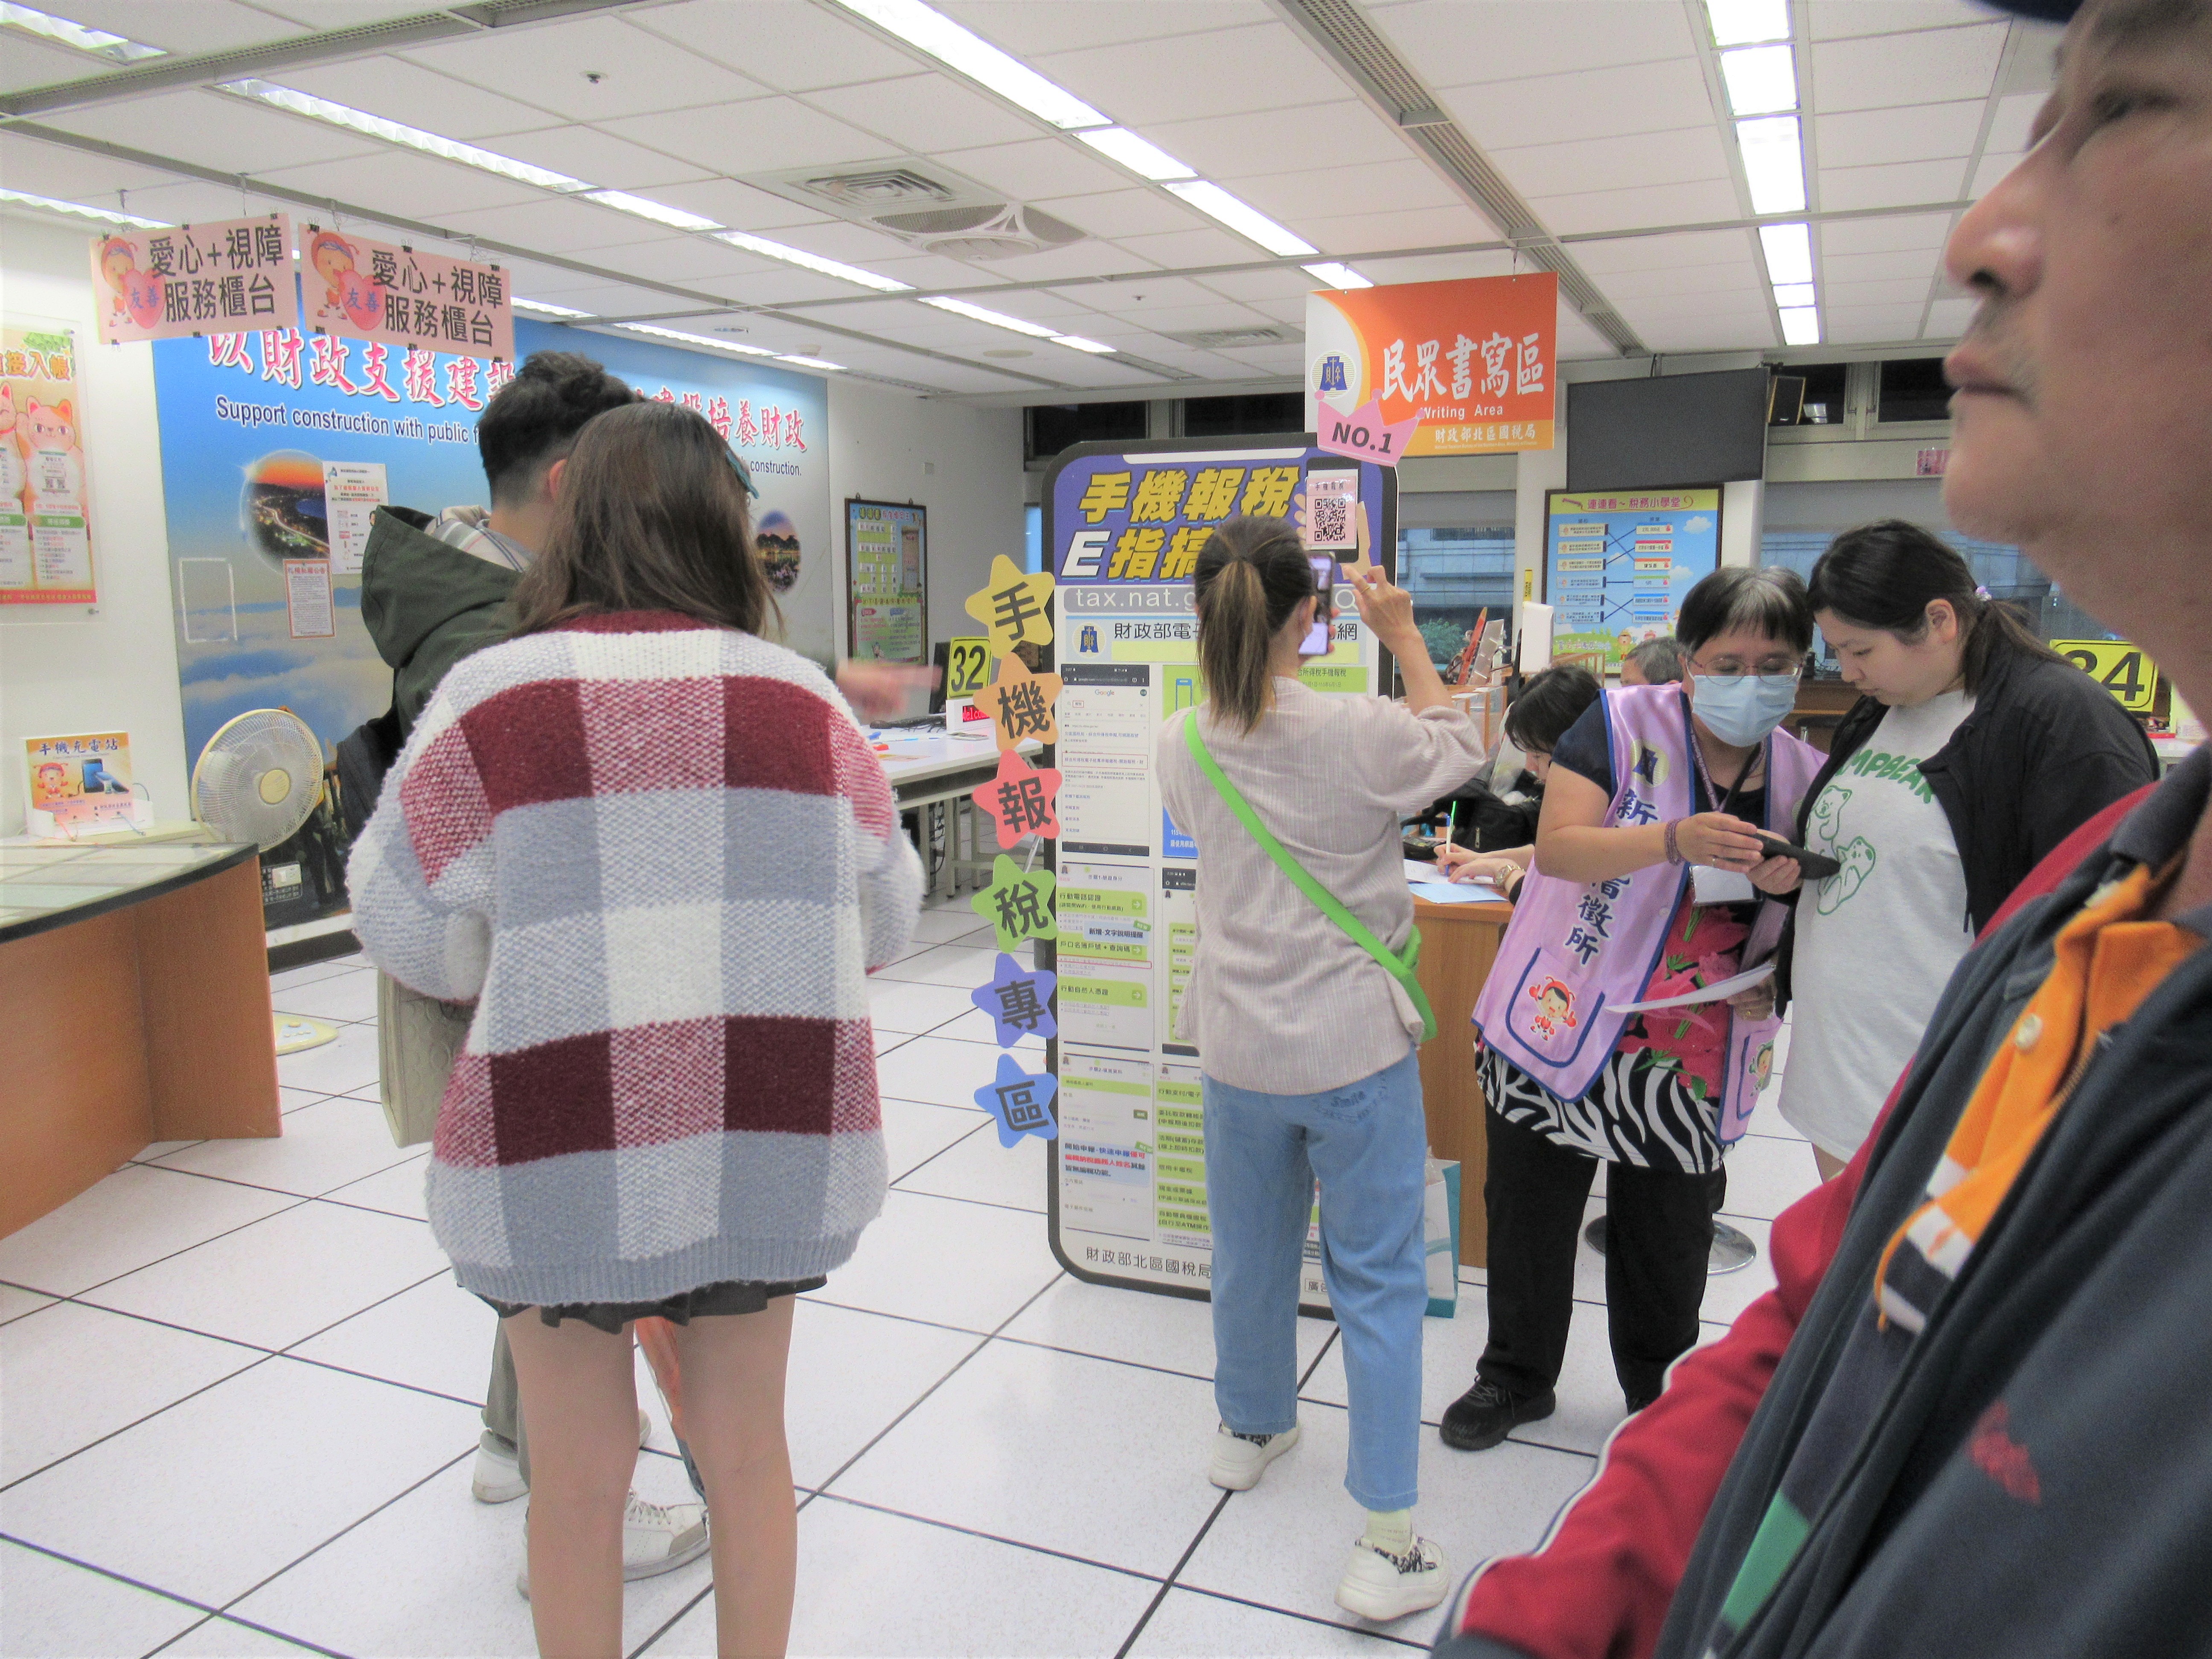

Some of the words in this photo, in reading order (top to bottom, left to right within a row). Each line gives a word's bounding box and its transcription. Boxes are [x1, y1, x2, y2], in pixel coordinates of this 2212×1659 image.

[150, 225, 283, 279] 愛心+視障
[372, 250, 504, 309] 愛心+視障
[129, 285, 160, 309] 友善
[164, 274, 276, 323] 服務櫃台
[347, 289, 378, 311] 友善
[385, 294, 494, 347] 服務櫃台
[0, 350, 71, 381] 接入帳
[1382, 332, 1544, 402] 民眾書寫區
[216, 396, 286, 427] Support
[292, 409, 389, 435] construction
[394, 417, 423, 439] with
[428, 423, 469, 444] public
[1422, 407, 1464, 421] Writing
[1474, 404, 1503, 416] Area
[1332, 422, 1393, 454] NO.1
[1435, 424, 1535, 443] 財政部北區國稅局
[750, 461, 802, 476] construction.
[1079, 466, 1299, 523] 手機報稅
[1629, 496, 1681, 508] 稅務小學堂
[1330, 623, 1357, 640] 網
[952, 646, 986, 692] 32
[39, 738, 118, 755] 手機充電站
[1060, 892, 1100, 901] 行動電話認證
[1061, 985, 1108, 995] 行動自然人憑證
[1086, 1246, 1211, 1279] 財政部北區國稅局
